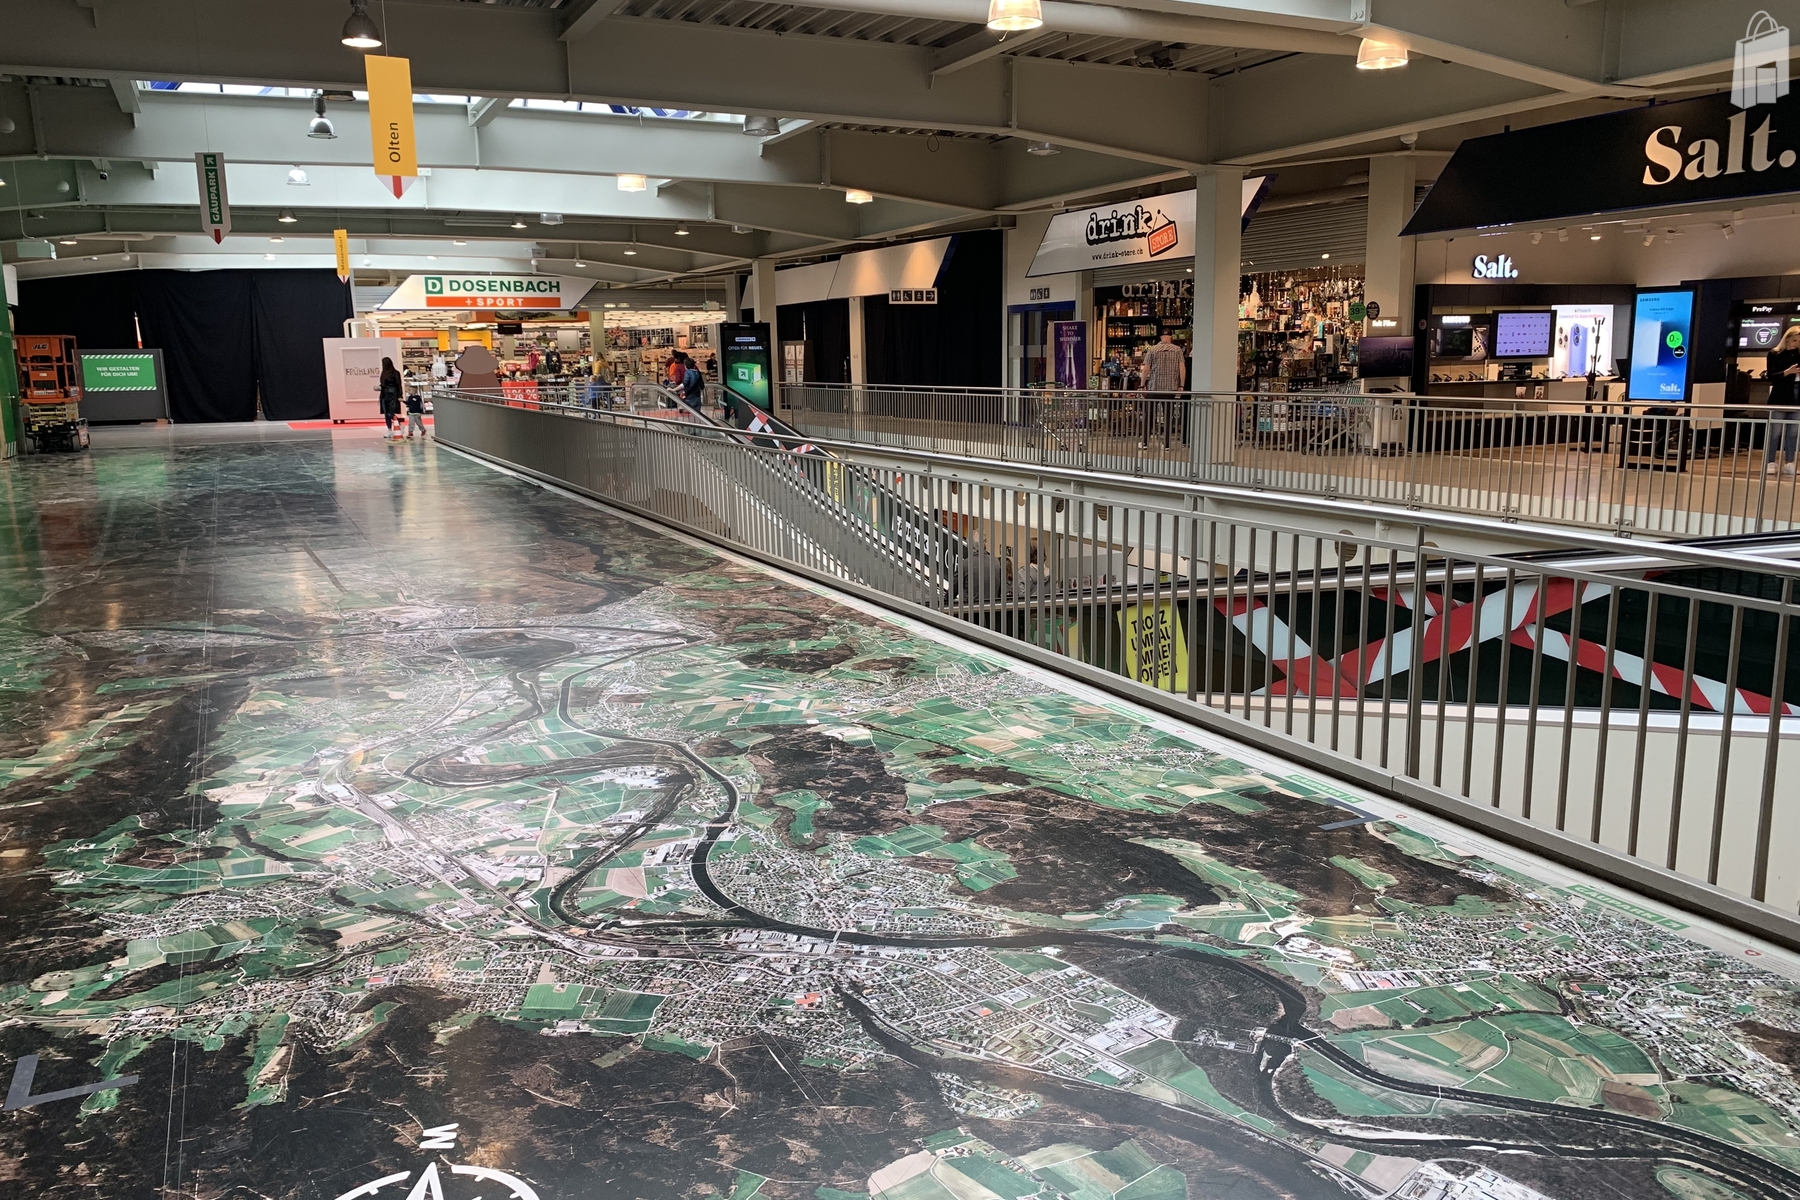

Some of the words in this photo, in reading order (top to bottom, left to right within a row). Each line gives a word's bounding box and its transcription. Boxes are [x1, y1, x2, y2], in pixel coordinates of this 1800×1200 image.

[388, 122, 401, 163] Olten
[1643, 110, 1797, 185] Salt.
[208, 171, 220, 222] GÄUPARK
[1086, 205, 1152, 245] drink
[1152, 229, 1174, 249] STORE
[1091, 247, 1144, 261] www.drink-store.ch
[1473, 254, 1519, 279] Salt.
[449, 279, 561, 293] DOSENBACH
[477, 298, 524, 307] SPORT
[345, 367, 380, 376] FRÜHLING
[1660, 382, 1681, 392] Salt.
